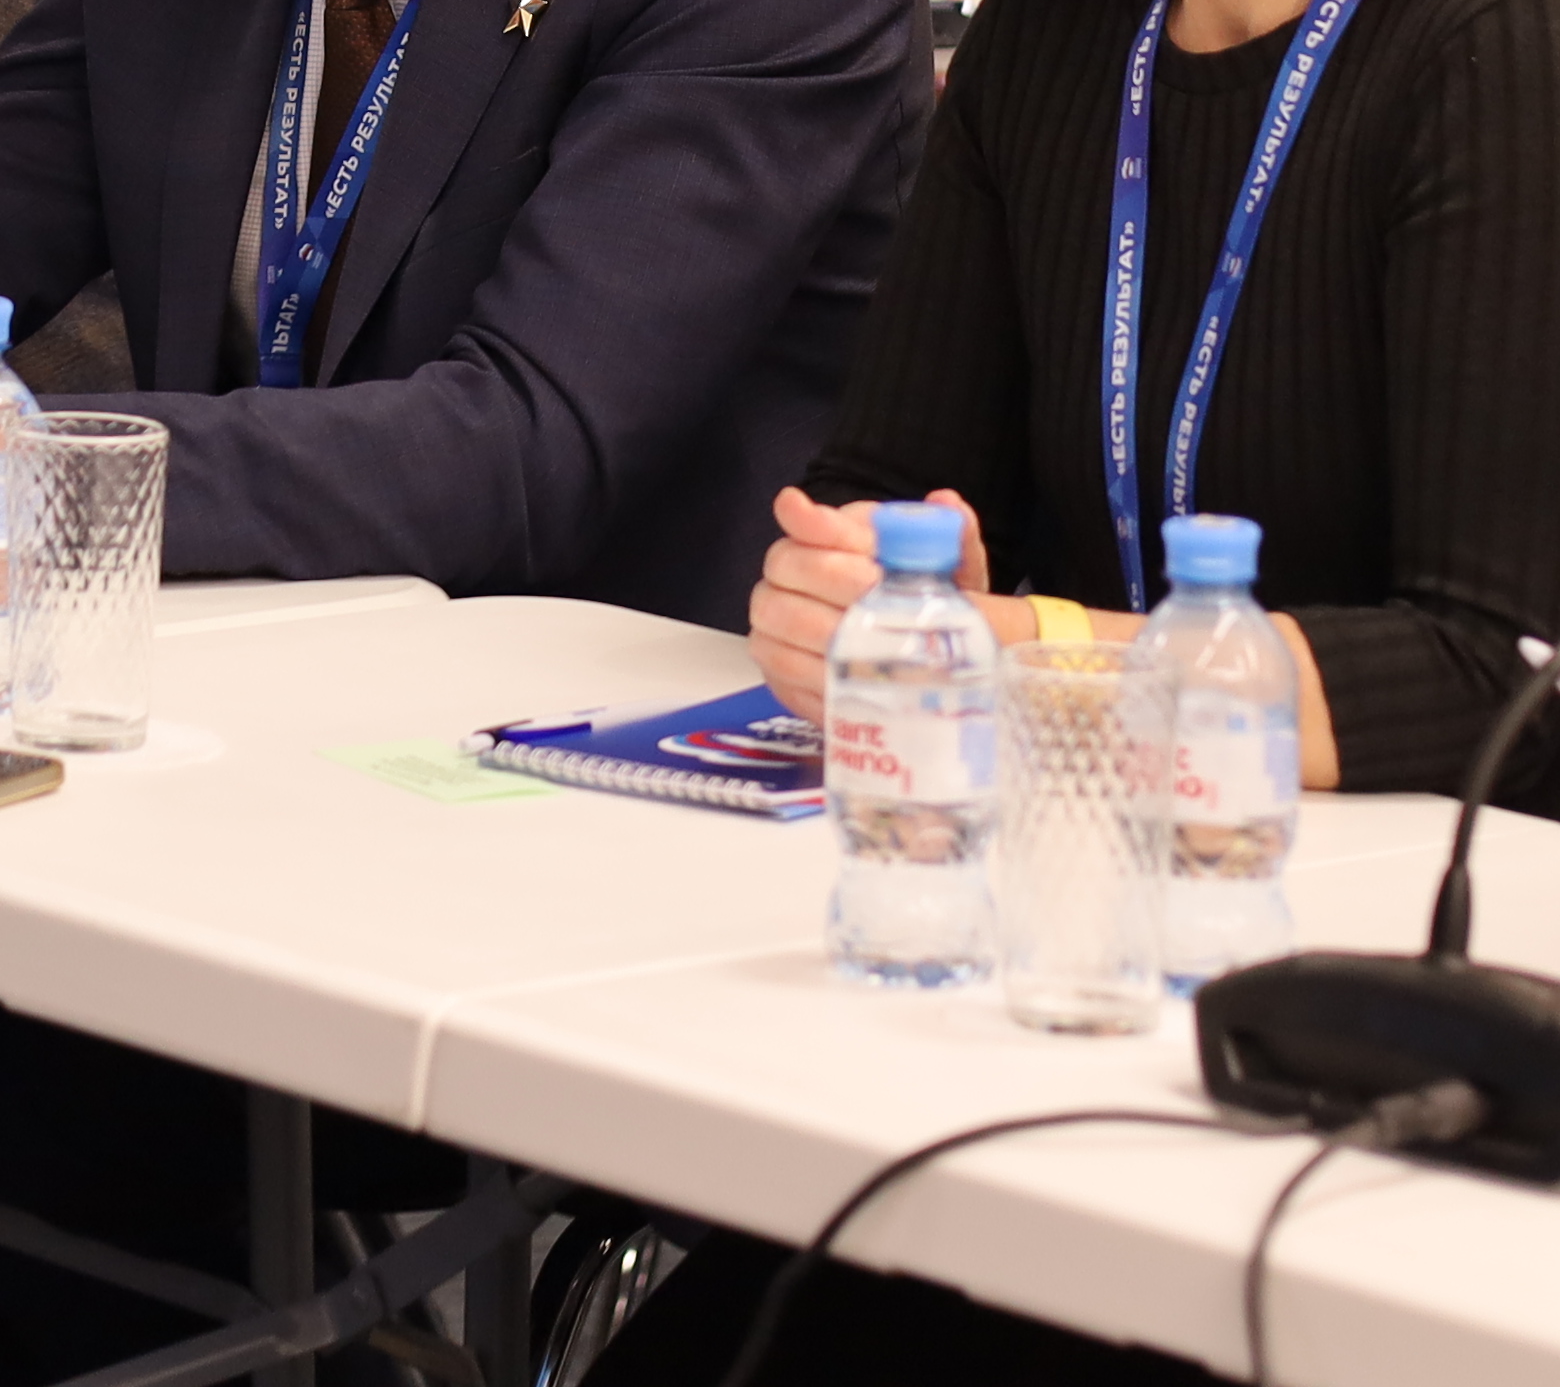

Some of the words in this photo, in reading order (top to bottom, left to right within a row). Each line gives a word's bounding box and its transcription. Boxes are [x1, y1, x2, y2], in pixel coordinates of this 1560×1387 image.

[287, 11, 306, 81] «ЕСТЬ
[273, 86, 299, 230] РЕЗУЛЬТАТ»
[1244, 53, 1314, 214] РЕЗУЛЬТАТ»
[325, 154, 360, 219] «ЕСТЬ
[1111, 221, 1134, 386] РЕЗУЛЬТАТ»
[1188, 315, 1220, 396] «ЕСТЬ
[1110, 392, 1127, 476] «ЕСТЬ
